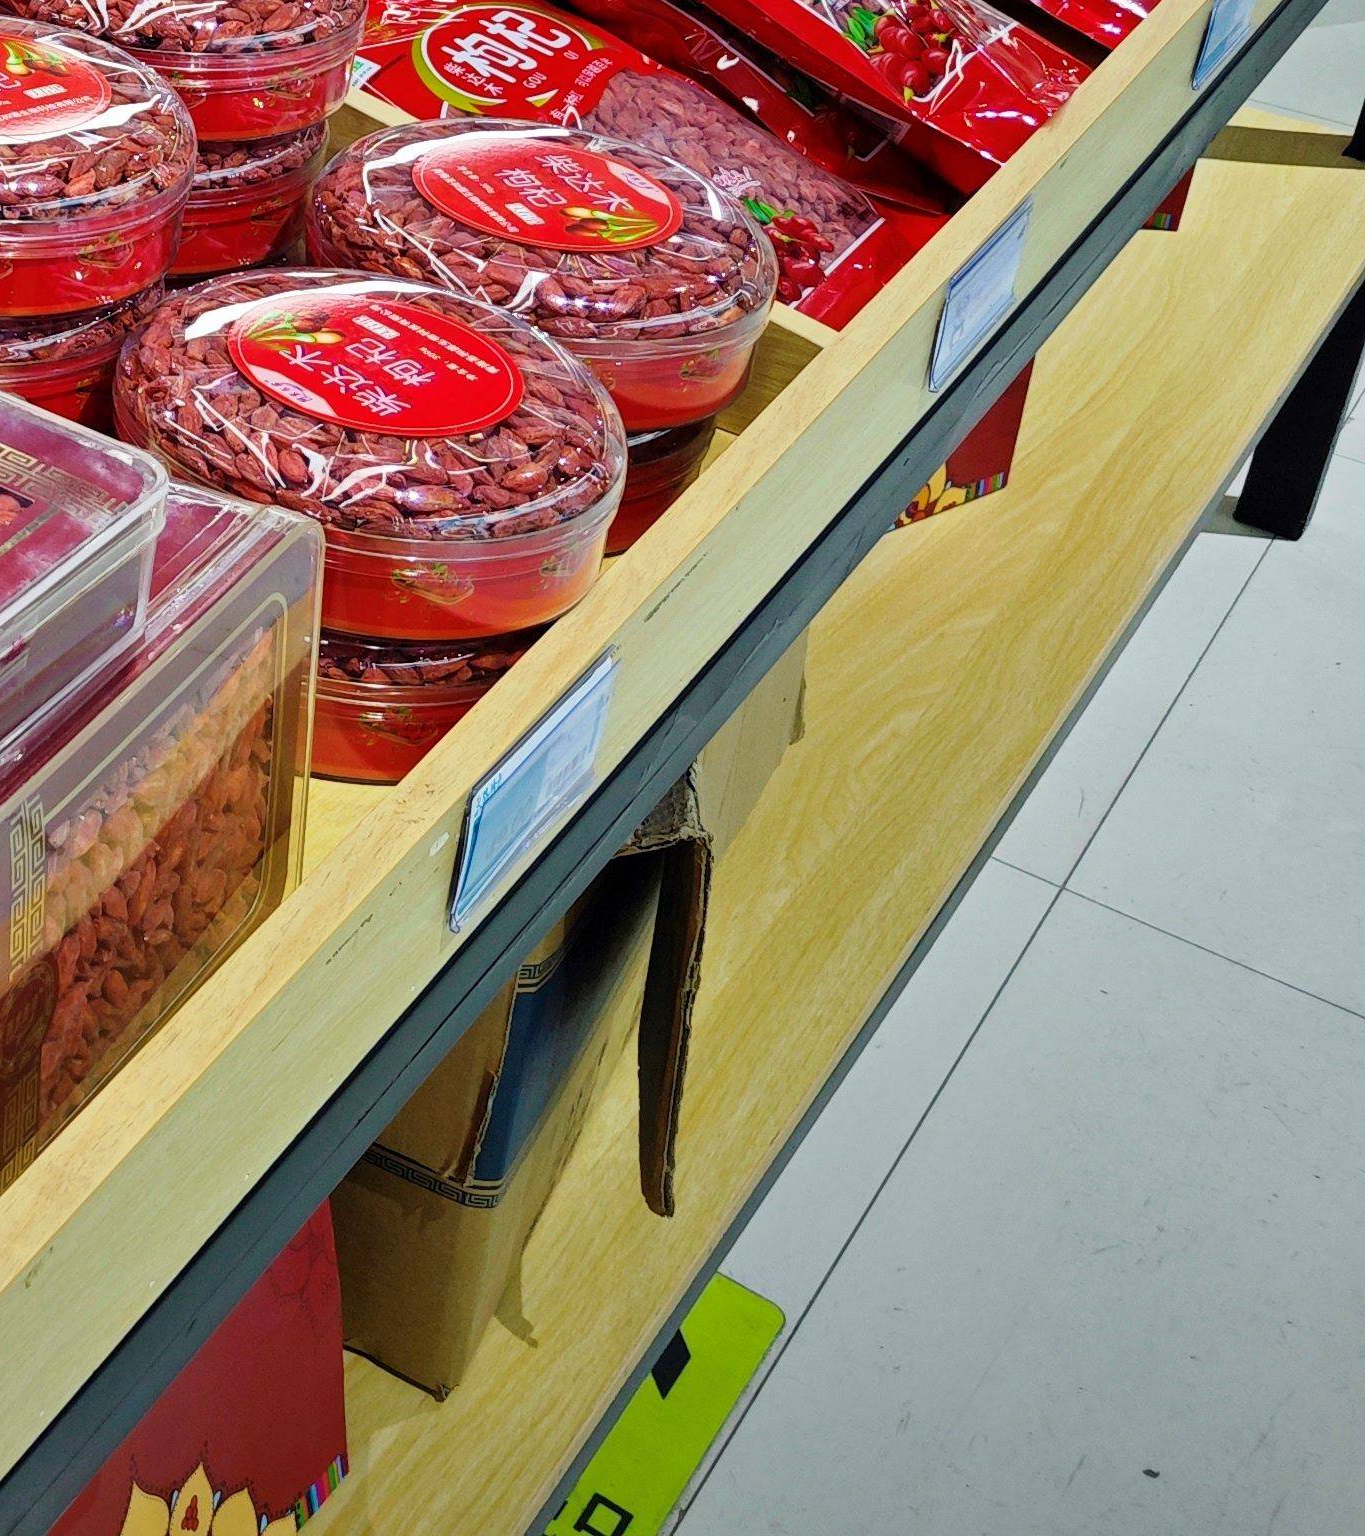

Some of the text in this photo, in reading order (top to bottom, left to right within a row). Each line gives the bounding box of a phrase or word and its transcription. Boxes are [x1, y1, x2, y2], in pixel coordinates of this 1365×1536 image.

[449, 9, 571, 80] 枸杞
[495, 167, 569, 209] 枸杞
[536, 153, 635, 215] 柴达木
[279, 344, 414, 418] 柴达木
[346, 339, 437, 388] 枸杞
